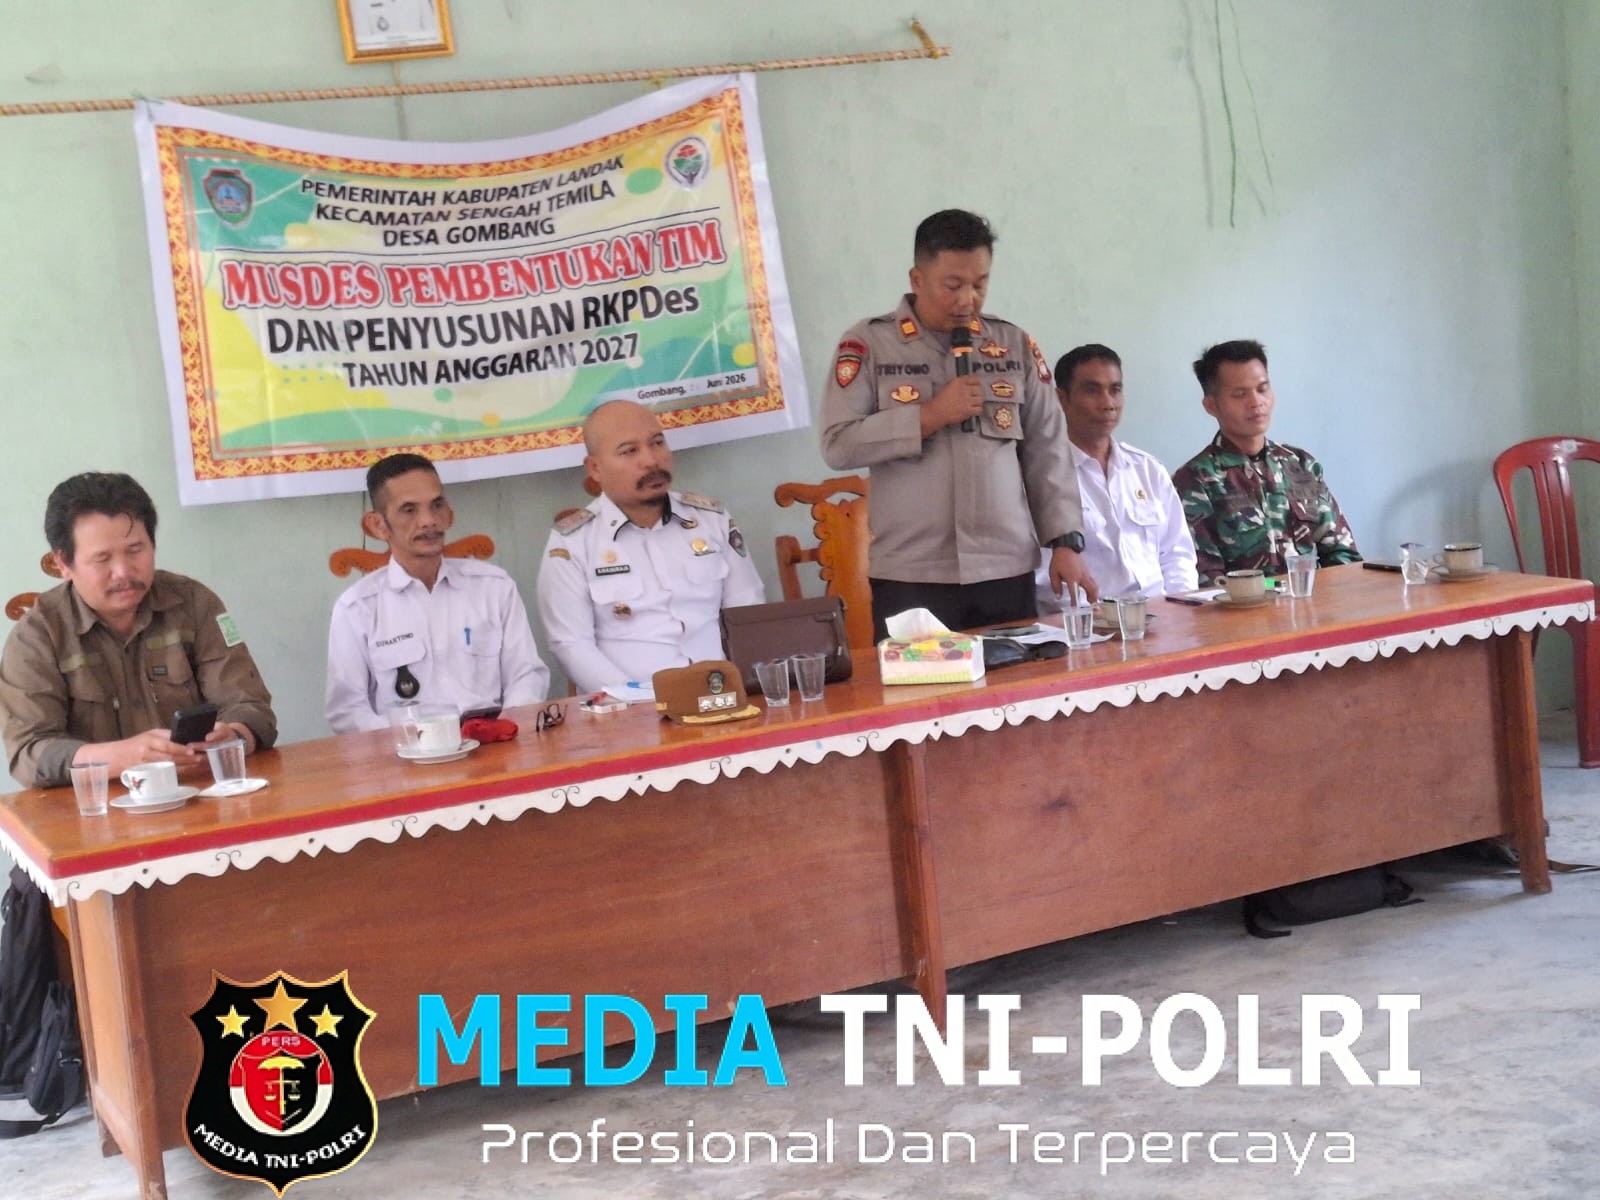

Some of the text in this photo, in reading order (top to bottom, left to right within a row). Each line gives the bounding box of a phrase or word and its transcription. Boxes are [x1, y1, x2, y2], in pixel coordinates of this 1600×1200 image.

[302, 154, 624, 206] PEMERINTAH KABUPATEN LANDAK
[316, 179, 615, 226] KECAMATAN SENGAH TEMILA
[383, 218, 555, 248] DESA GOMBANG
[222, 221, 724, 307] MUSDES PEMBENTUKAN TIM
[267, 285, 700, 354] DAN PENYUSUNAN RKPDes
[342, 332, 639, 388] TAHUN ANGGARAN 2027
[725, 373, 747, 385] 2026
[971, 361, 1021, 373] POLRI
